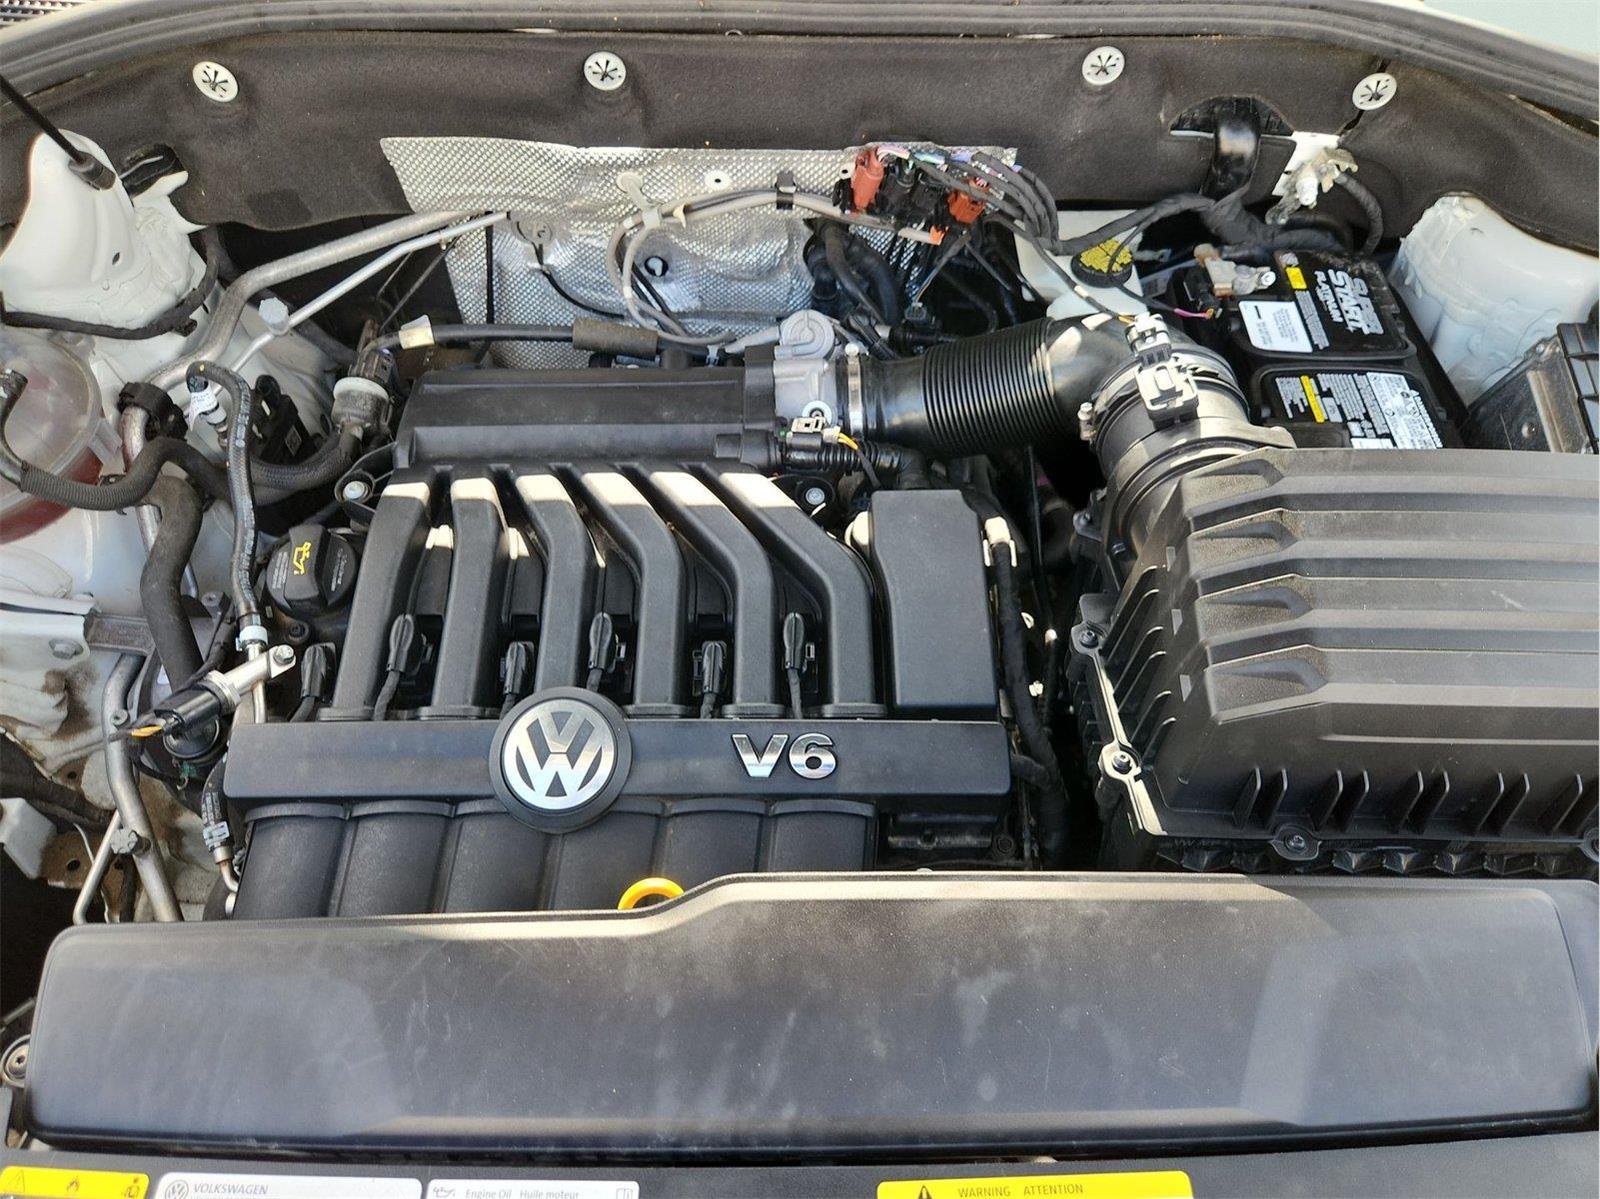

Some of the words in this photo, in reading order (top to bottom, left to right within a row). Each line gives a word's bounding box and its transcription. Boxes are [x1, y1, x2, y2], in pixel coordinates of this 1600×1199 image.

[1327, 269, 1371, 335] START
[503, 698, 616, 811] VW
[731, 733, 837, 780] V6
[193, 1183, 269, 1195] VOLKSWAGEN
[465, 1189, 496, 1199] Engine
[498, 1189, 513, 1199] Oil
[519, 1189, 543, 1199] Huile
[545, 1190, 580, 1199] moteur
[958, 1186, 1011, 1197] WARNING
[1023, 1184, 1083, 1195] ATTENTION
